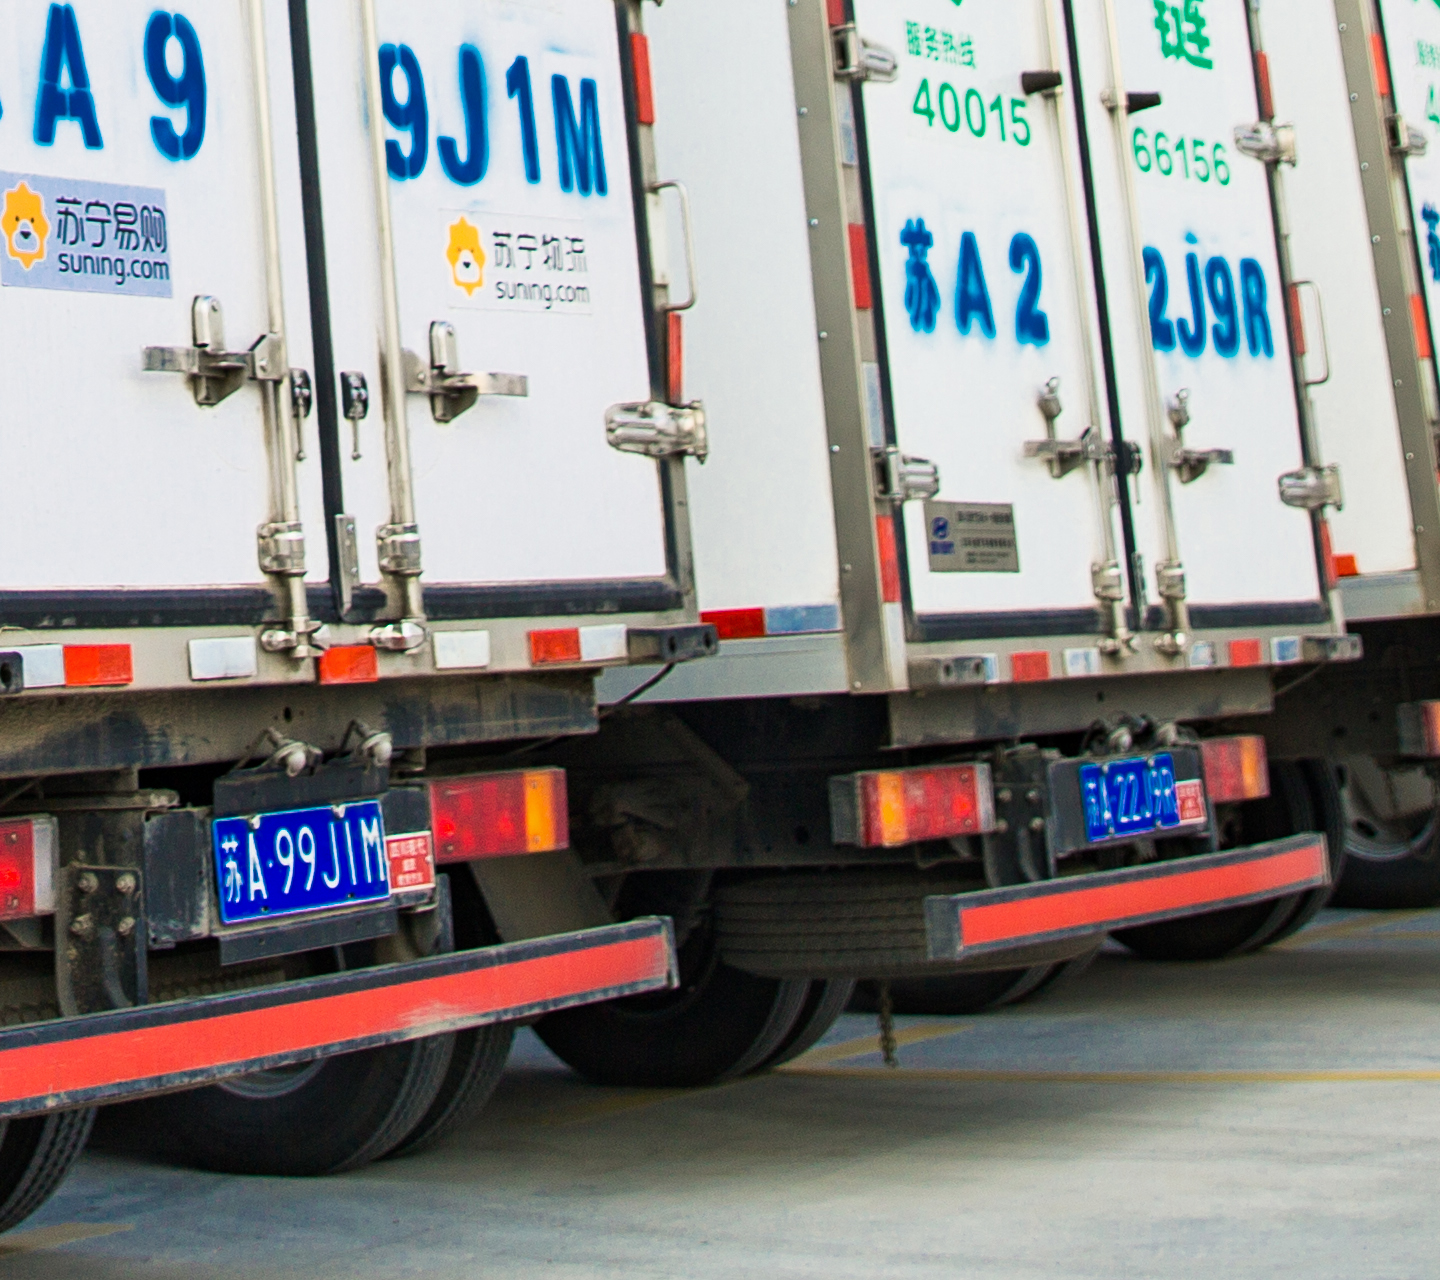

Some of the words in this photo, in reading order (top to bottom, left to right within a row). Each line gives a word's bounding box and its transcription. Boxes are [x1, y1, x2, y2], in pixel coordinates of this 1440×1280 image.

[376, 42, 608, 197] 9J1M
[912, 77, 1032, 146] 40015
[1132, 127, 1231, 186] 66156
[55, 195, 168, 254] 苏宁易购
[492, 230, 588, 274] 苏宁物流
[58, 251, 171, 286] suning.com
[495, 278, 590, 311] suning.com
